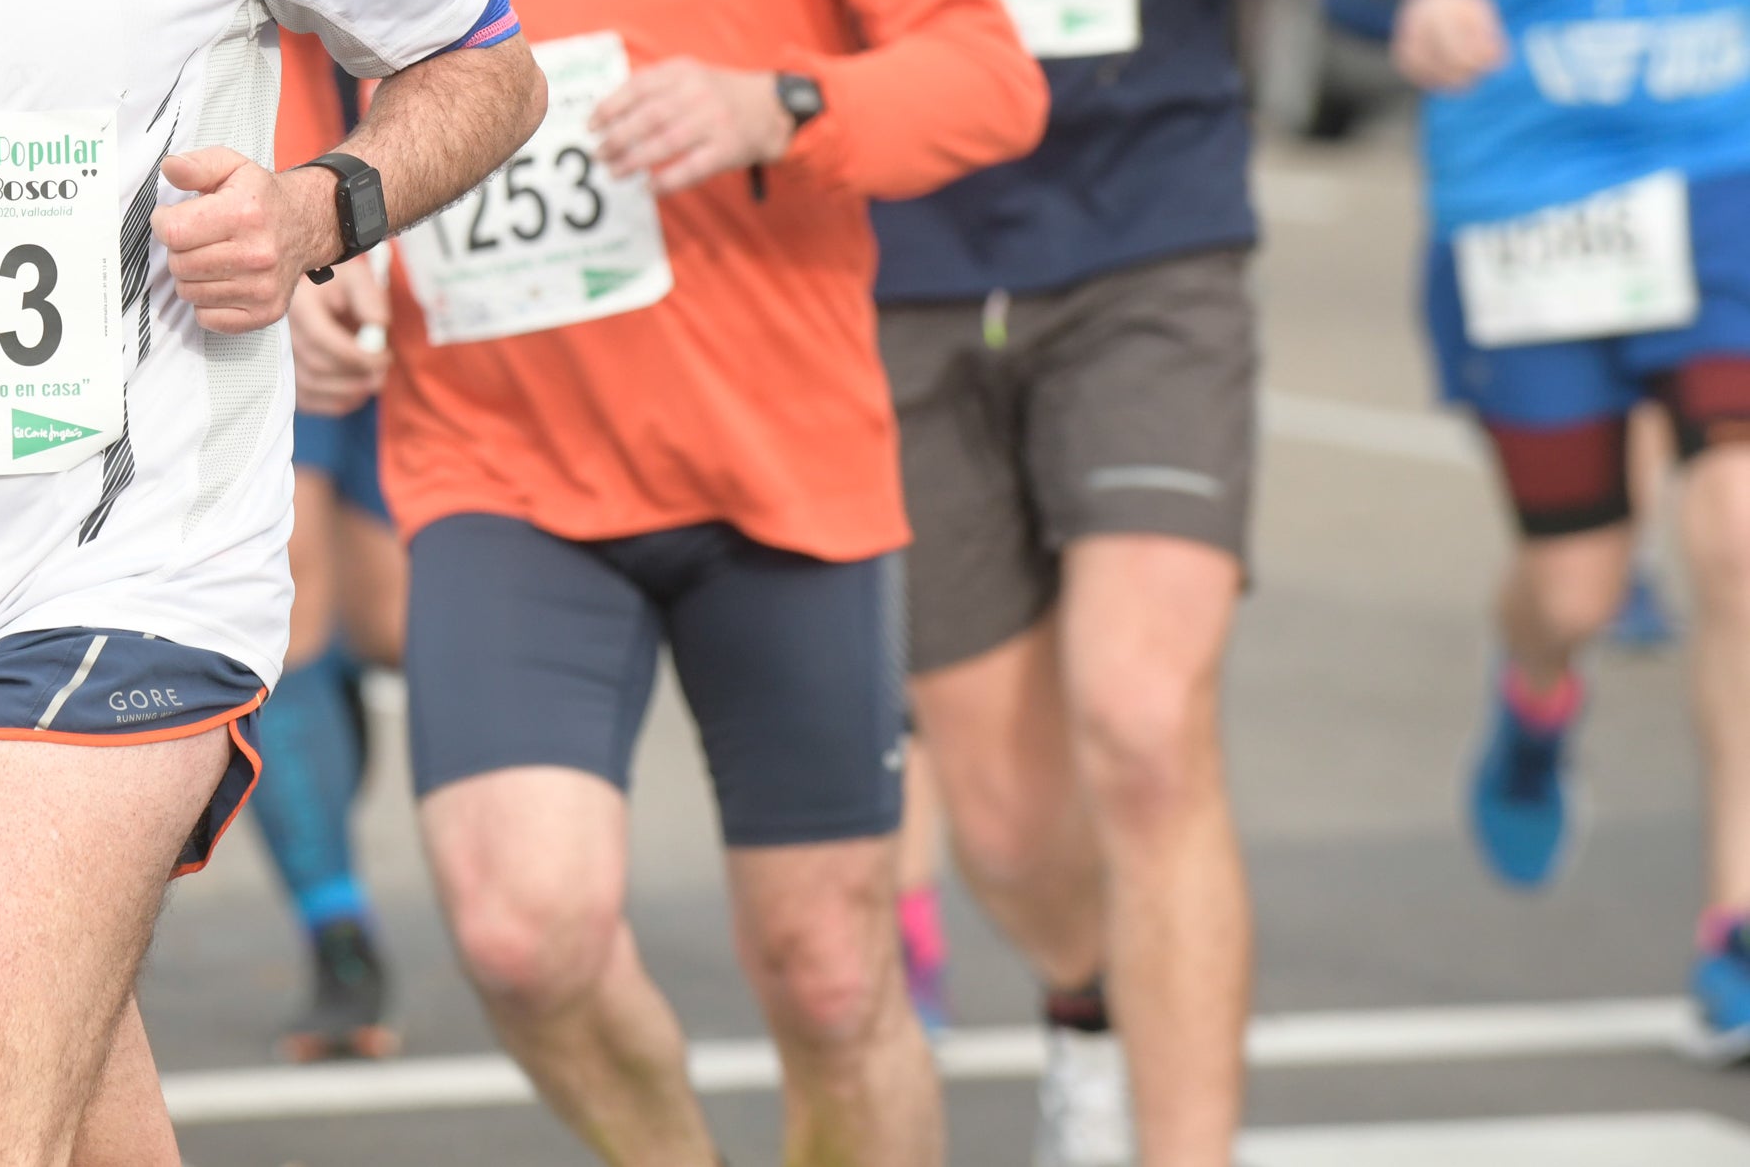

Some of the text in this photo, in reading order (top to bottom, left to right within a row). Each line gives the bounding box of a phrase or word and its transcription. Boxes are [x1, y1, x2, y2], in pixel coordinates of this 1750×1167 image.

[21, 205, 73, 218] Valladolid
[15, 383, 35, 398] en
[108, 688, 183, 711] GORE
[116, 712, 157, 723] RUNNING
